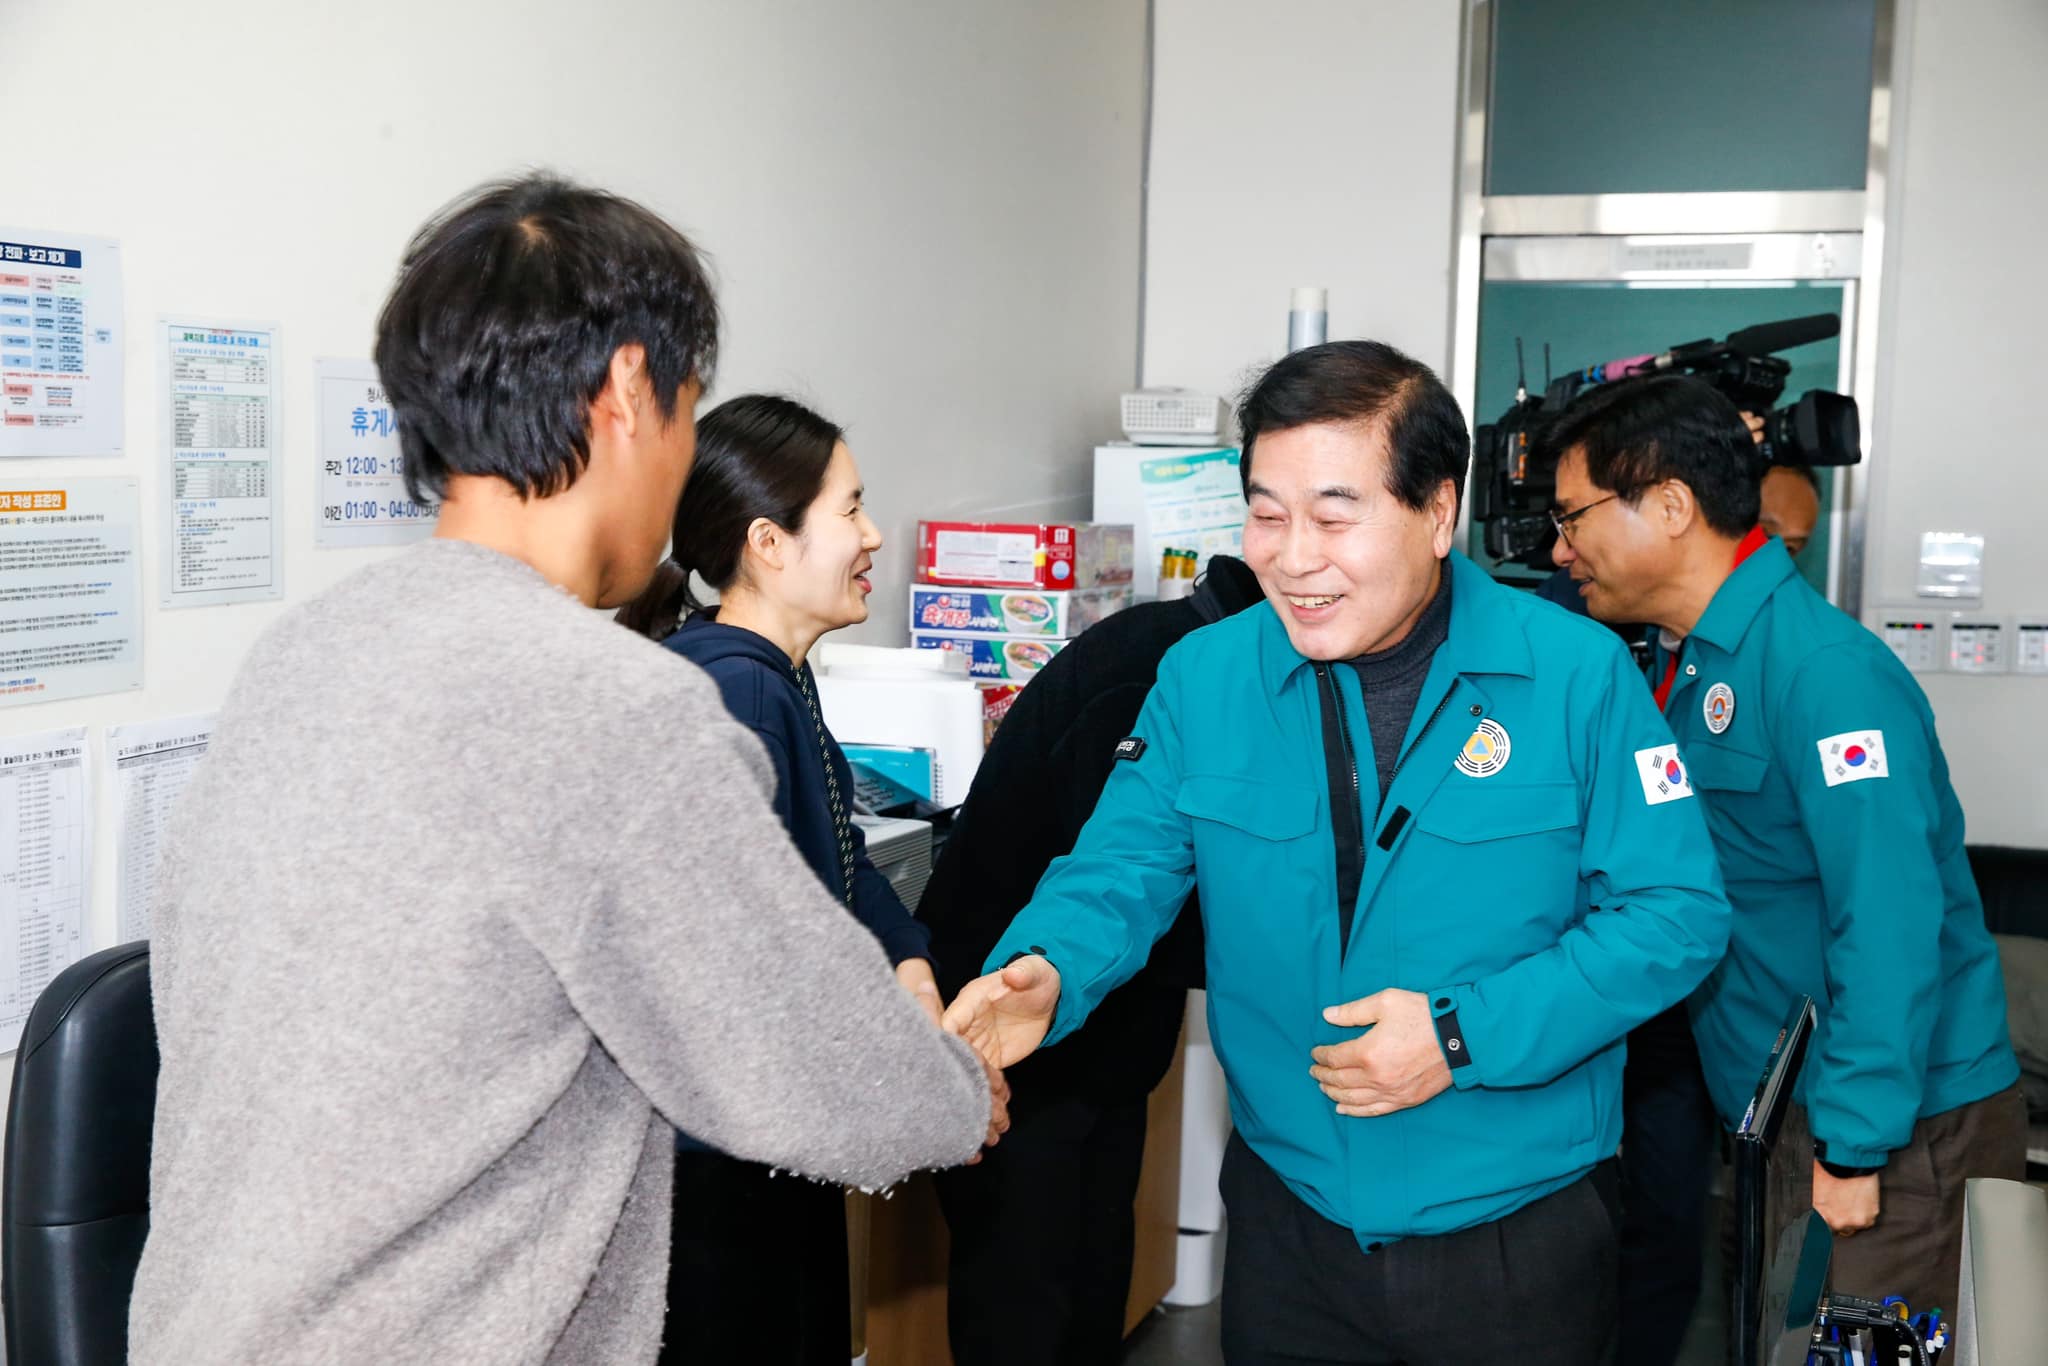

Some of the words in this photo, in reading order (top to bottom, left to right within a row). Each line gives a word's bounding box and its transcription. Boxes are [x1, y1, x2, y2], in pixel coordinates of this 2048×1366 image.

[325, 460, 342, 476] 주간
[346, 457, 377, 475] 12:00
[12, 494, 33, 509] 작성
[33, 493, 63, 508] 표준안
[324, 505, 342, 521] 야간
[345, 501, 377, 519] 01:00
[389, 501, 420, 519] 04:00
[922, 604, 971, 629] 육개장
